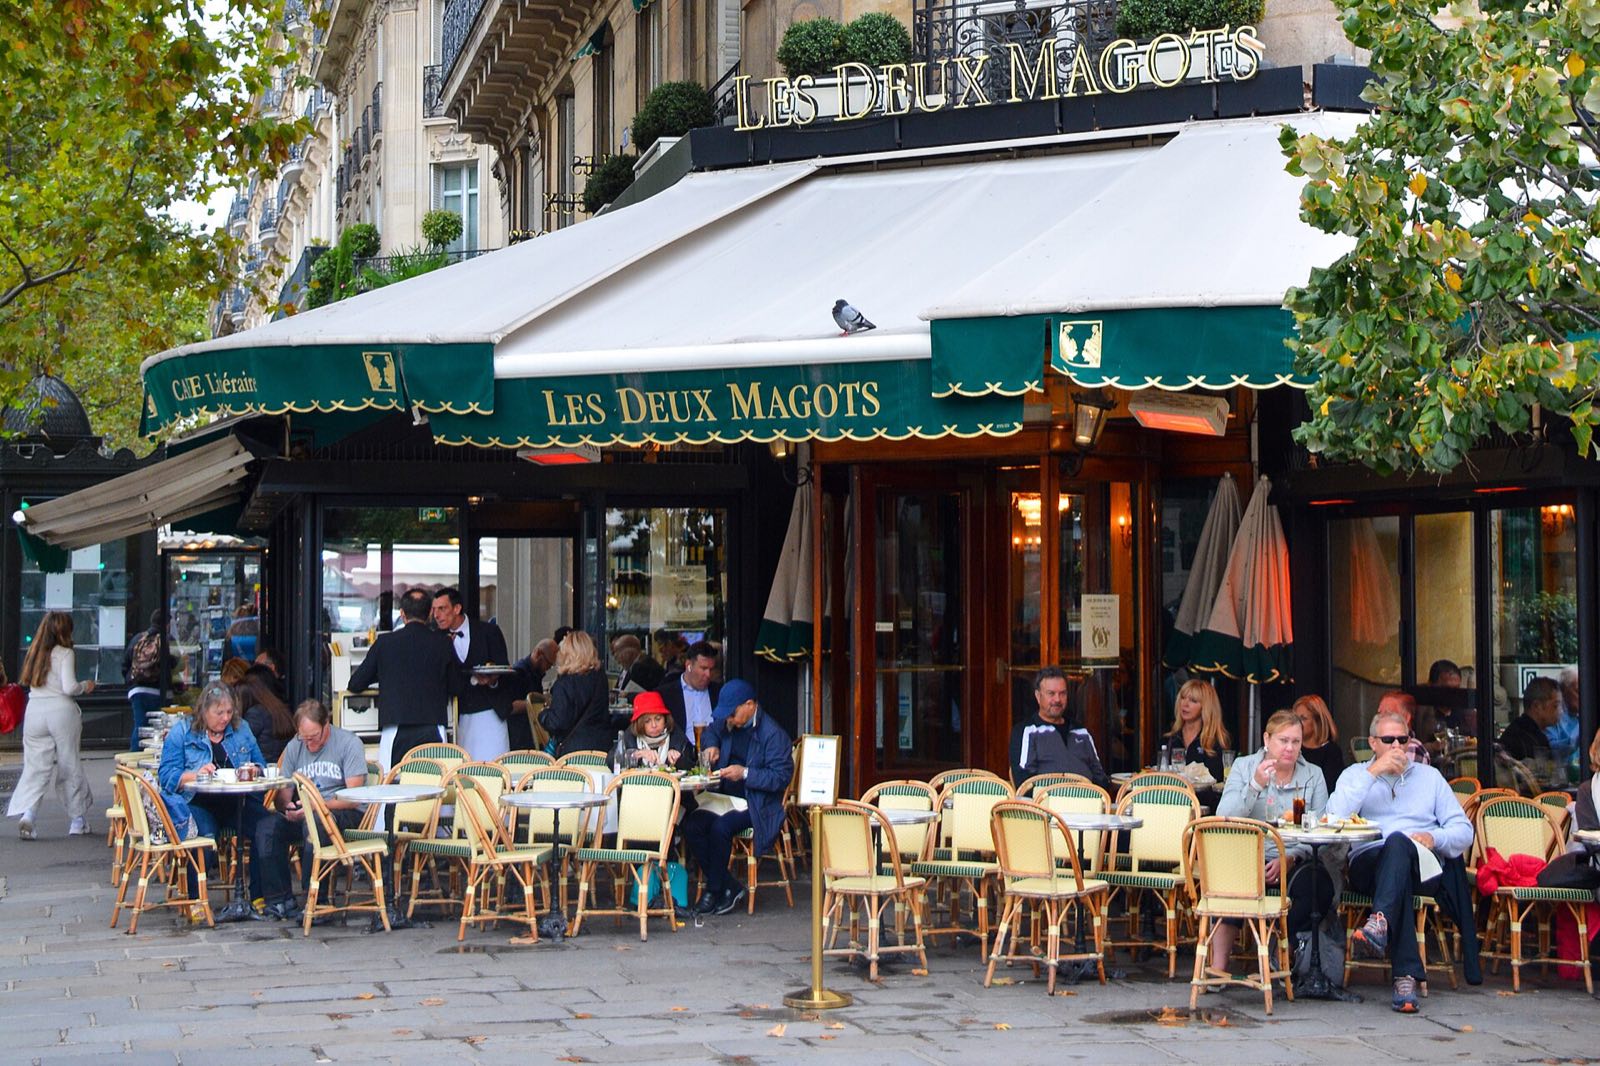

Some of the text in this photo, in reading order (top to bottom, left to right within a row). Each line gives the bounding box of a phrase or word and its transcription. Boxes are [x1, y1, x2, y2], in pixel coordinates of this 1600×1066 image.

[732, 23, 1259, 132] LES DEUX MAGOTS
[542, 381, 881, 426] LES DEUX MAGOTS
